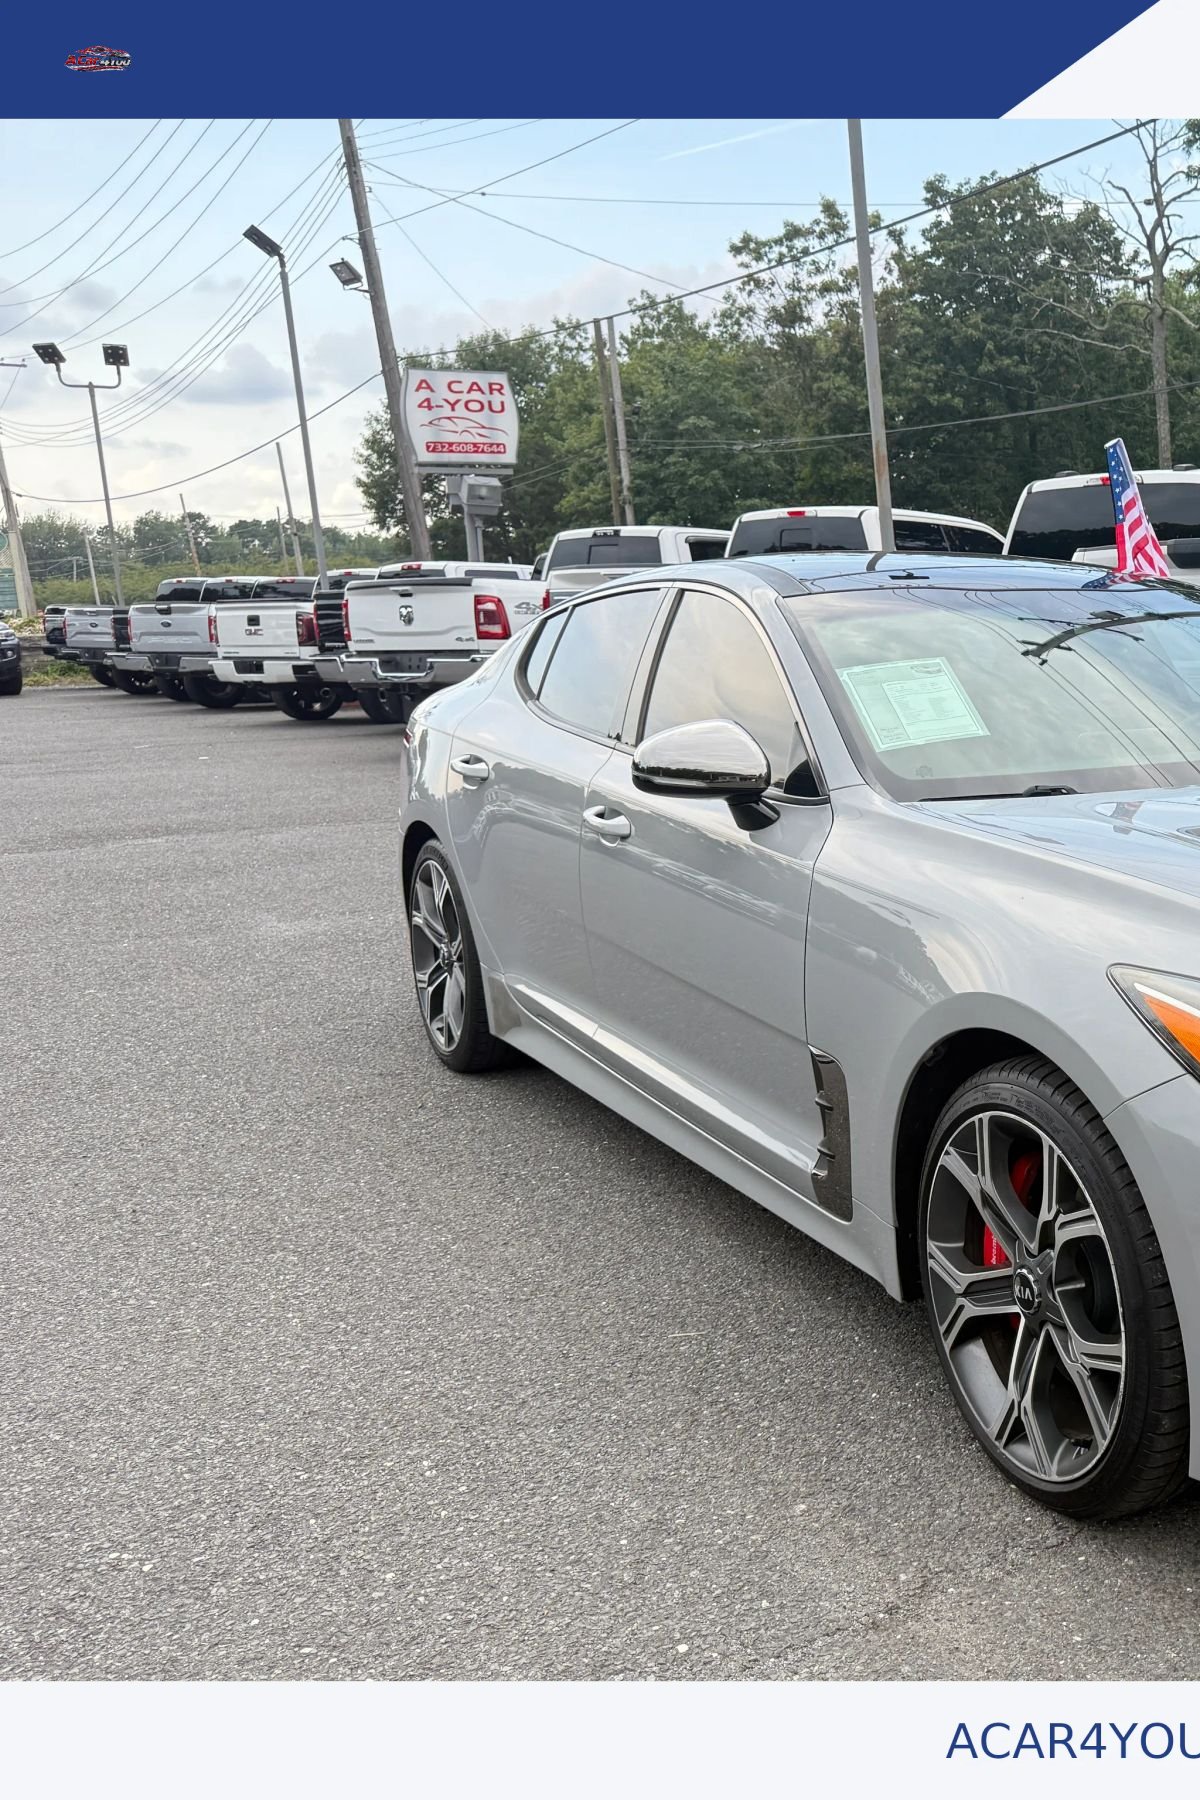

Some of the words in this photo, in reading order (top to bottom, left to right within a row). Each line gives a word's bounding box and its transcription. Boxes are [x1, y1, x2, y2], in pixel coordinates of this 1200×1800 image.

[415, 379, 436, 393] A
[447, 380, 506, 396] CAR
[417, 397, 506, 414] 4-YOU
[428, 443, 504, 453] 732-608-7644
[1014, 1285, 1033, 1301] KIA
